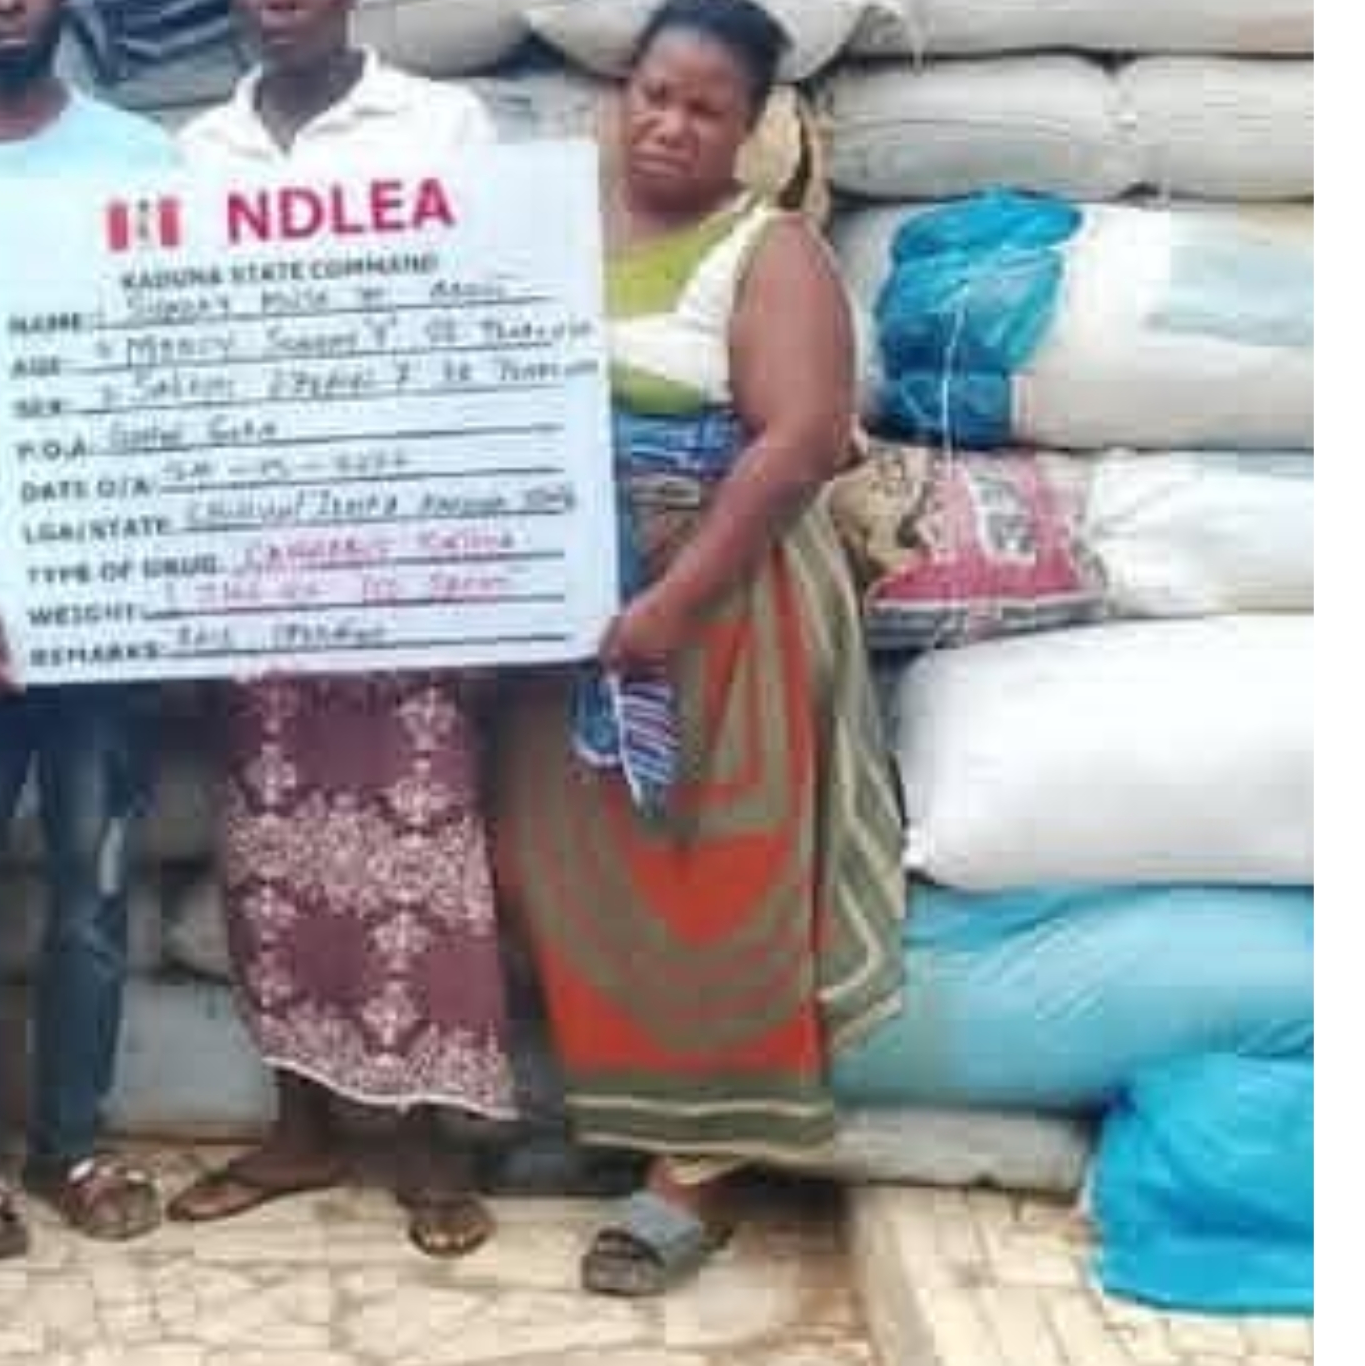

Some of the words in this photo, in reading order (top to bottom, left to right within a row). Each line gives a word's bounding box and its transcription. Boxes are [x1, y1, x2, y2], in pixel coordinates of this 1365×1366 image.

[226, 178, 456, 242] NDLEA
[121, 264, 223, 290] KADUNA
[230, 257, 309, 283] STATE
[310, 251, 439, 280] COMMAND
